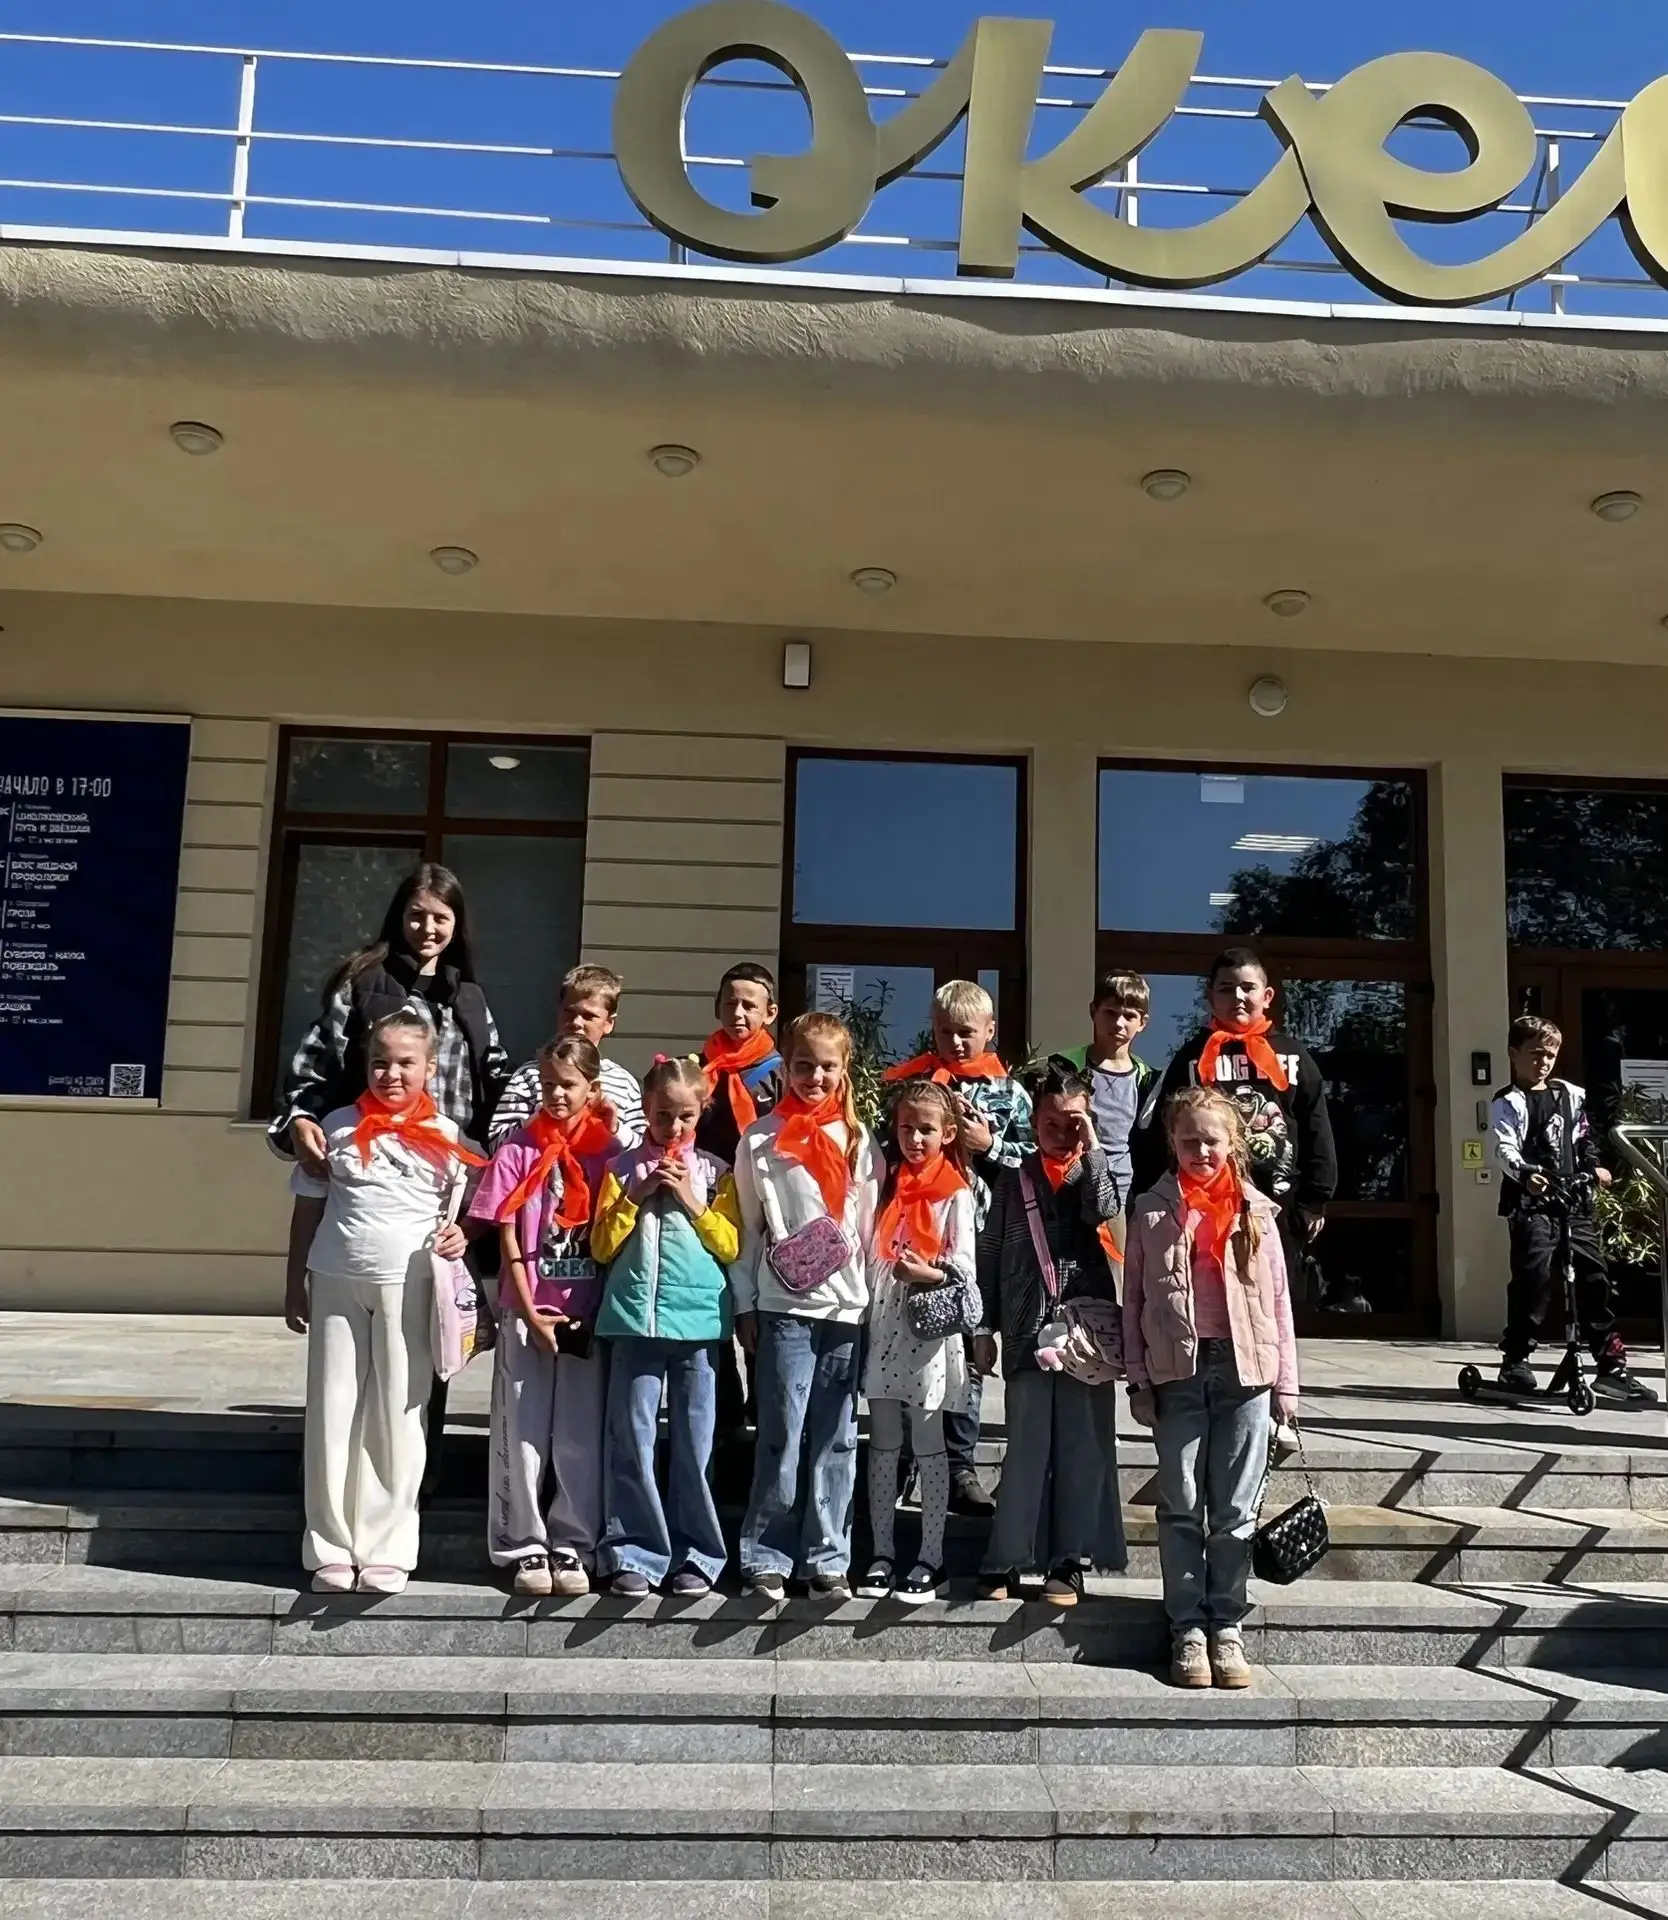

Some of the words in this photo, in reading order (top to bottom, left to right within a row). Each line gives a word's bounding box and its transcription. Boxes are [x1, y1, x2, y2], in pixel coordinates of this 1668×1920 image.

[612, 0, 1668, 307] Оке
[56, 777, 64, 795] В
[72, 777, 111, 797] 17:00
